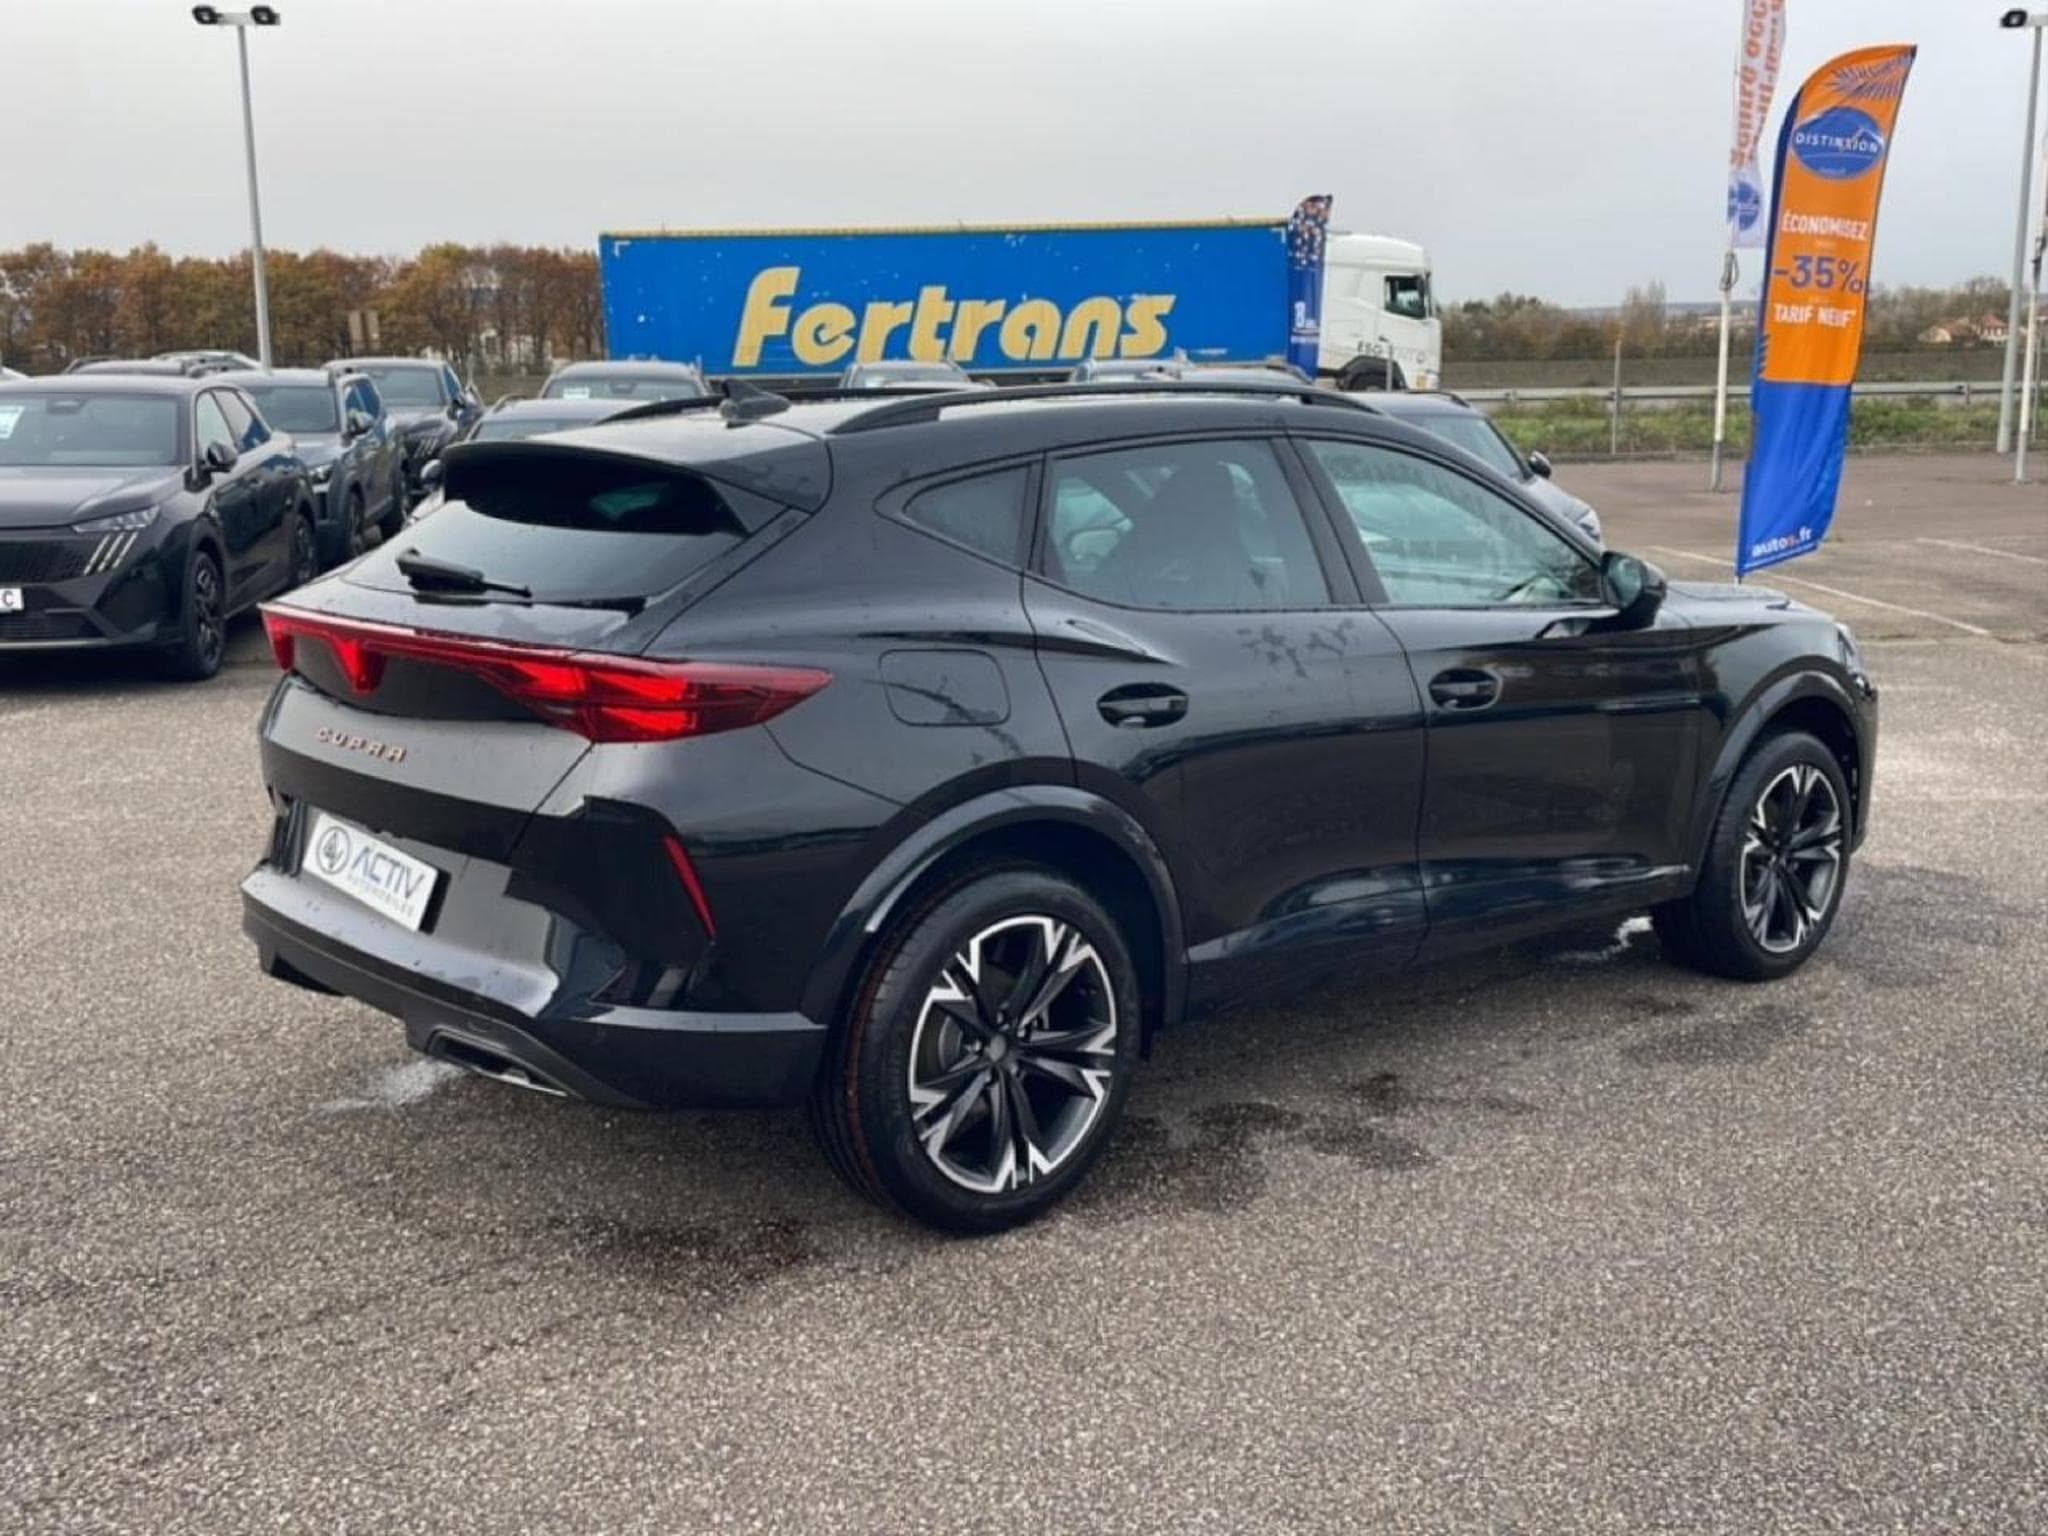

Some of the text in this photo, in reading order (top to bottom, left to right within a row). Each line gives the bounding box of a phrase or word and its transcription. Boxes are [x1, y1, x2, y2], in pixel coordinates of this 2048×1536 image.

[1782, 211, 1868, 240] ÉCONOMISEZ
[1774, 255, 1863, 293] -35%
[1774, 303, 1813, 326] TARIF
[350, 845, 426, 900] ACTIV
